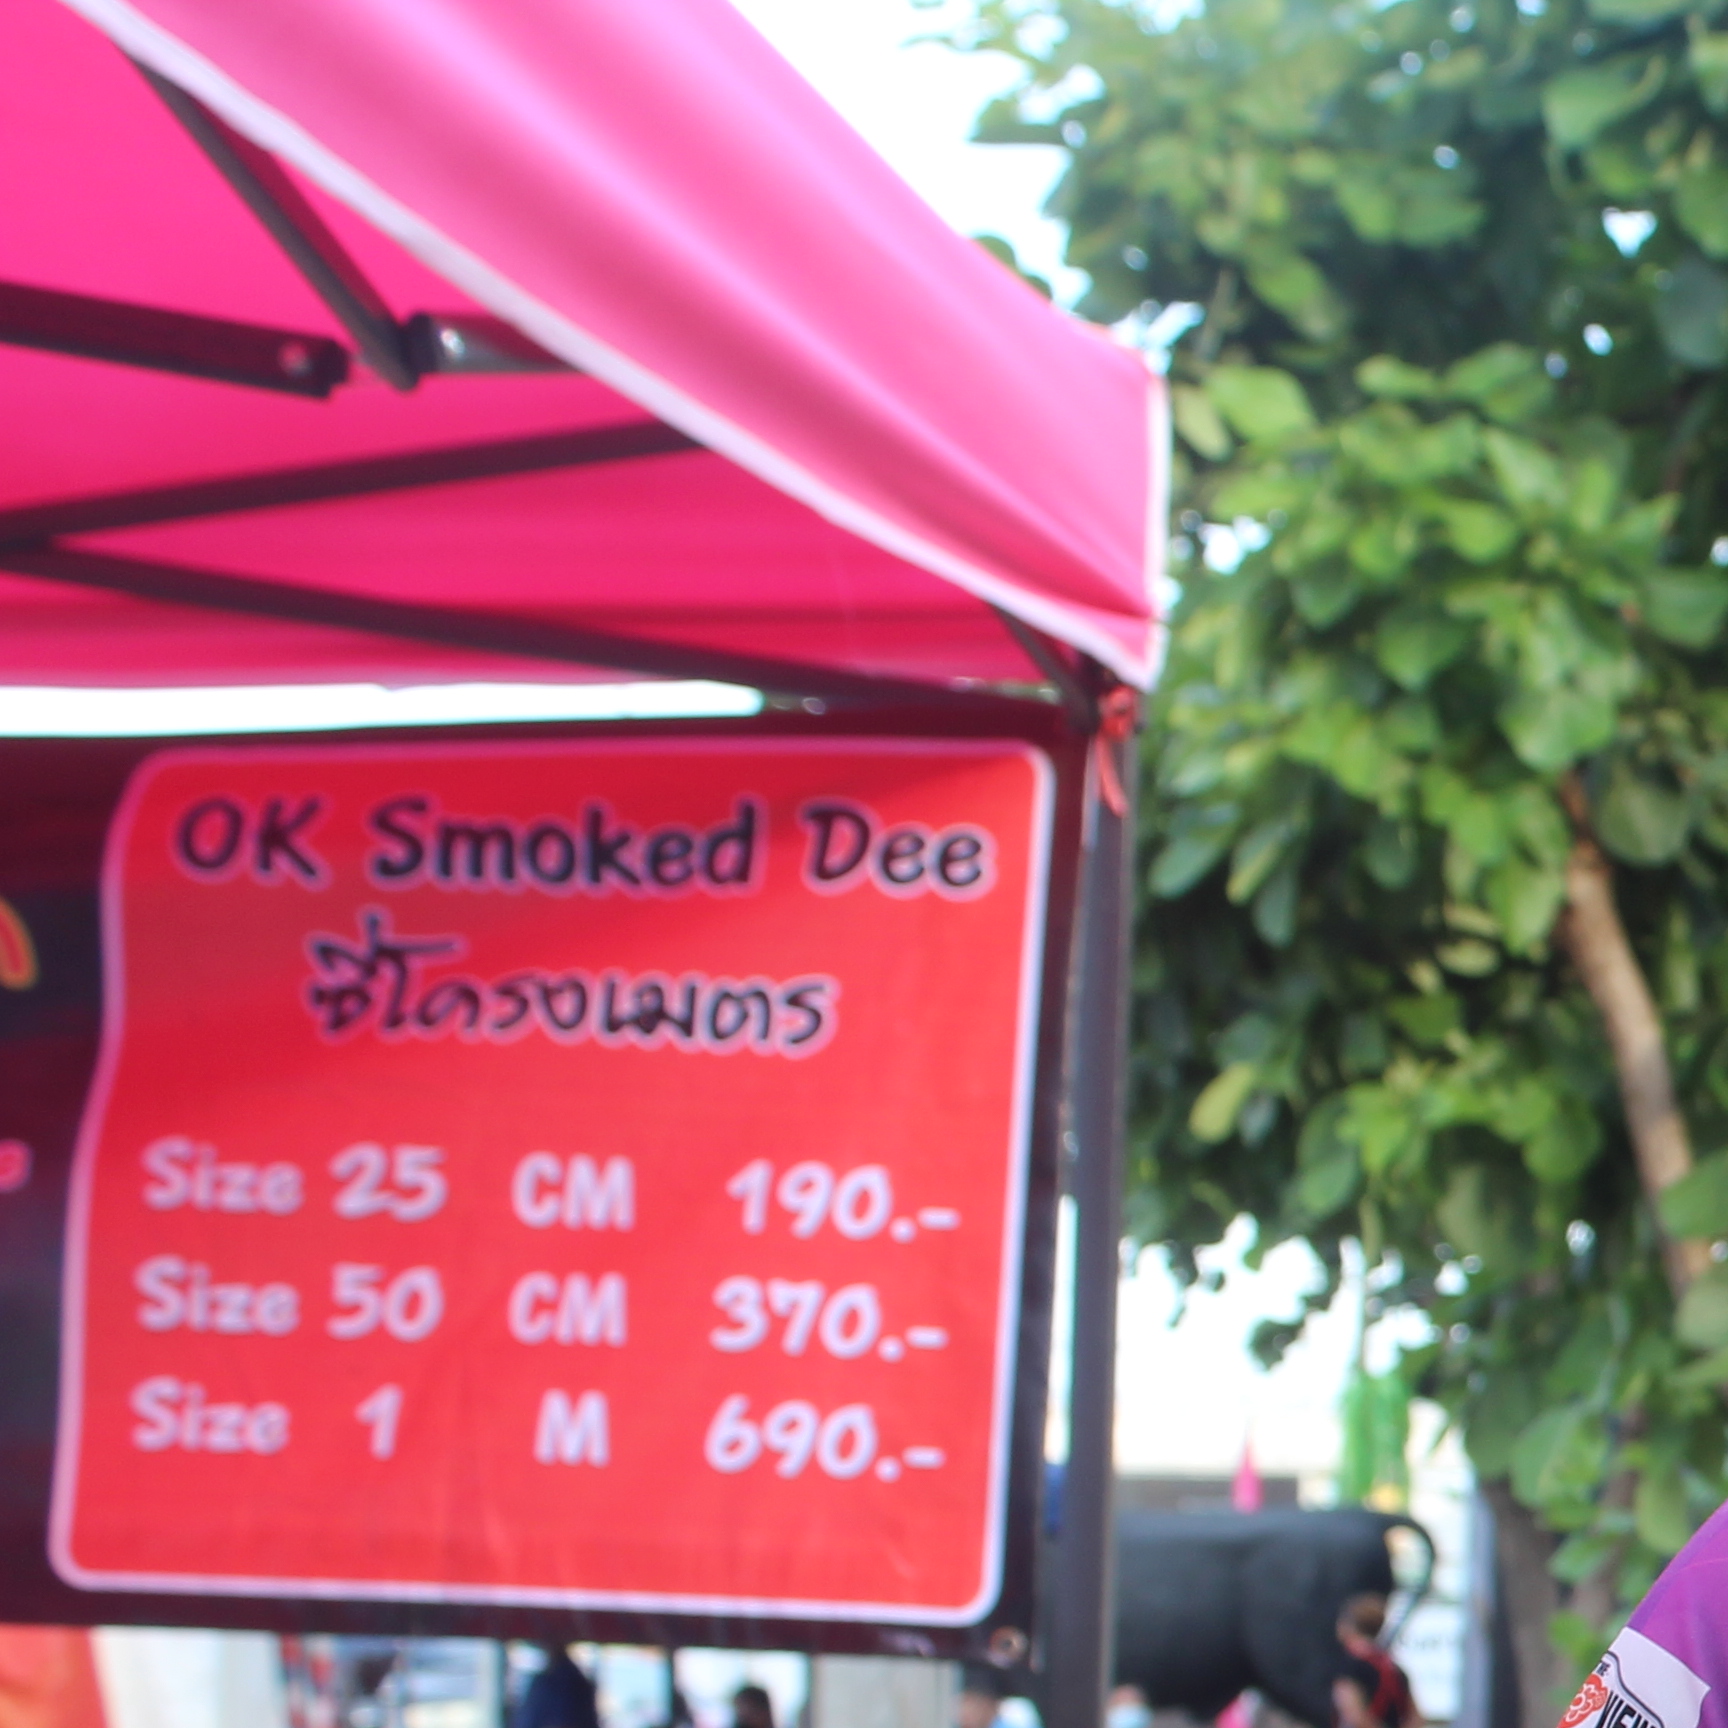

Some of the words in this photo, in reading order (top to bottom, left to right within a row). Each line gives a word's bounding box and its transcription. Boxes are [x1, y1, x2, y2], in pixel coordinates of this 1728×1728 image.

[174, 799, 324, 880] OK
[368, 801, 758, 888] Smoked
[803, 806, 986, 890] Dee
[143, 1137, 303, 1214] Size
[330, 1147, 447, 1221] 25
[511, 1153, 636, 1229] CM
[727, 1163, 961, 1243] 190.-
[134, 1257, 300, 1333] Size
[328, 1266, 443, 1342] 50
[507, 1272, 629, 1346] CM
[710, 1280, 951, 1358] 370.-
[131, 1377, 289, 1454] Size
[357, 1387, 399, 1459] 1
[534, 1391, 611, 1467] M
[704, 1396, 944, 1480] 690.-
